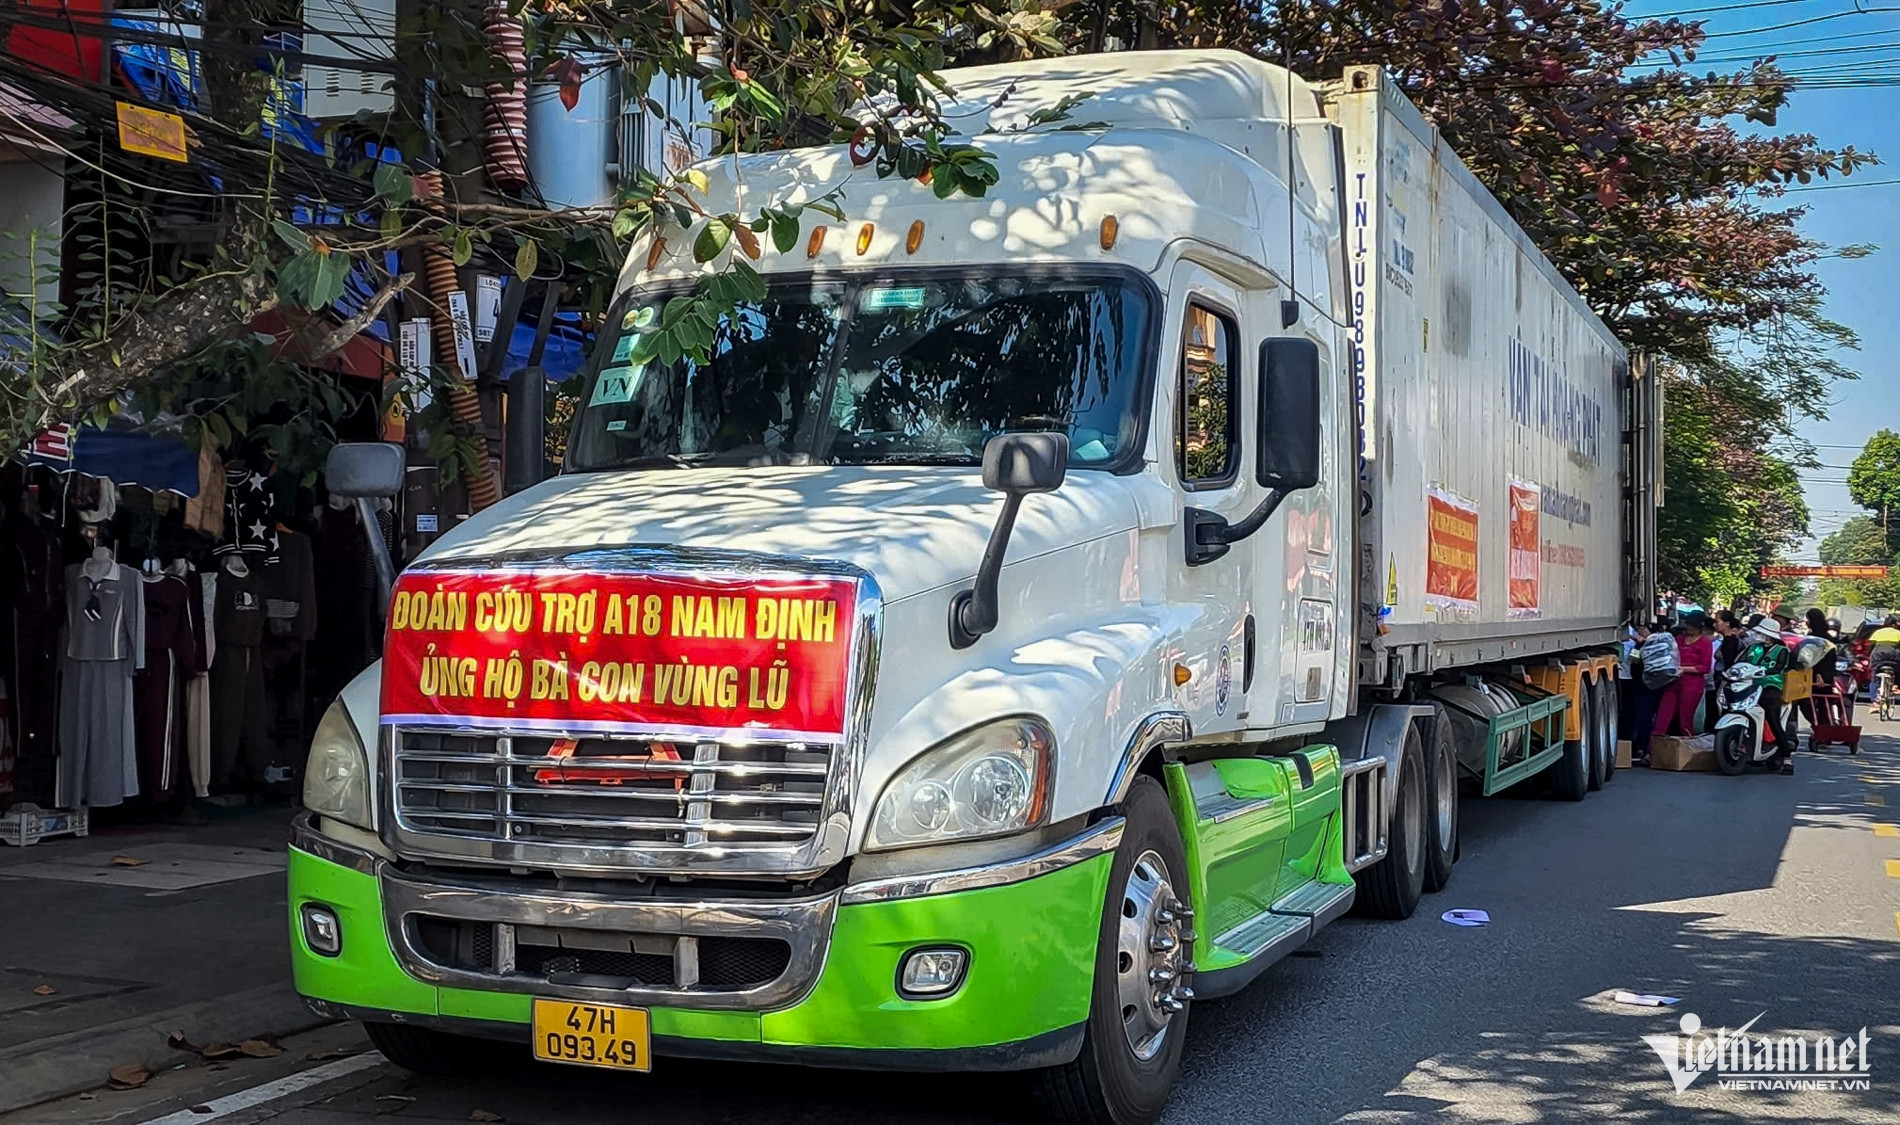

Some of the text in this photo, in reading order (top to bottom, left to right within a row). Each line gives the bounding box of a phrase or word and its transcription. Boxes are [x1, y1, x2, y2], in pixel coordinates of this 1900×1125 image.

[602, 376, 632, 397] VN
[392, 583, 836, 650] ĐOÀN CỨU TRỢ A18 NAM ĐỊNH
[419, 642, 790, 710] ỦNG HỘ BÀ CON VÙNG LŨ
[566, 1006, 616, 1035] 47H
[547, 1032, 637, 1066] 093.49
